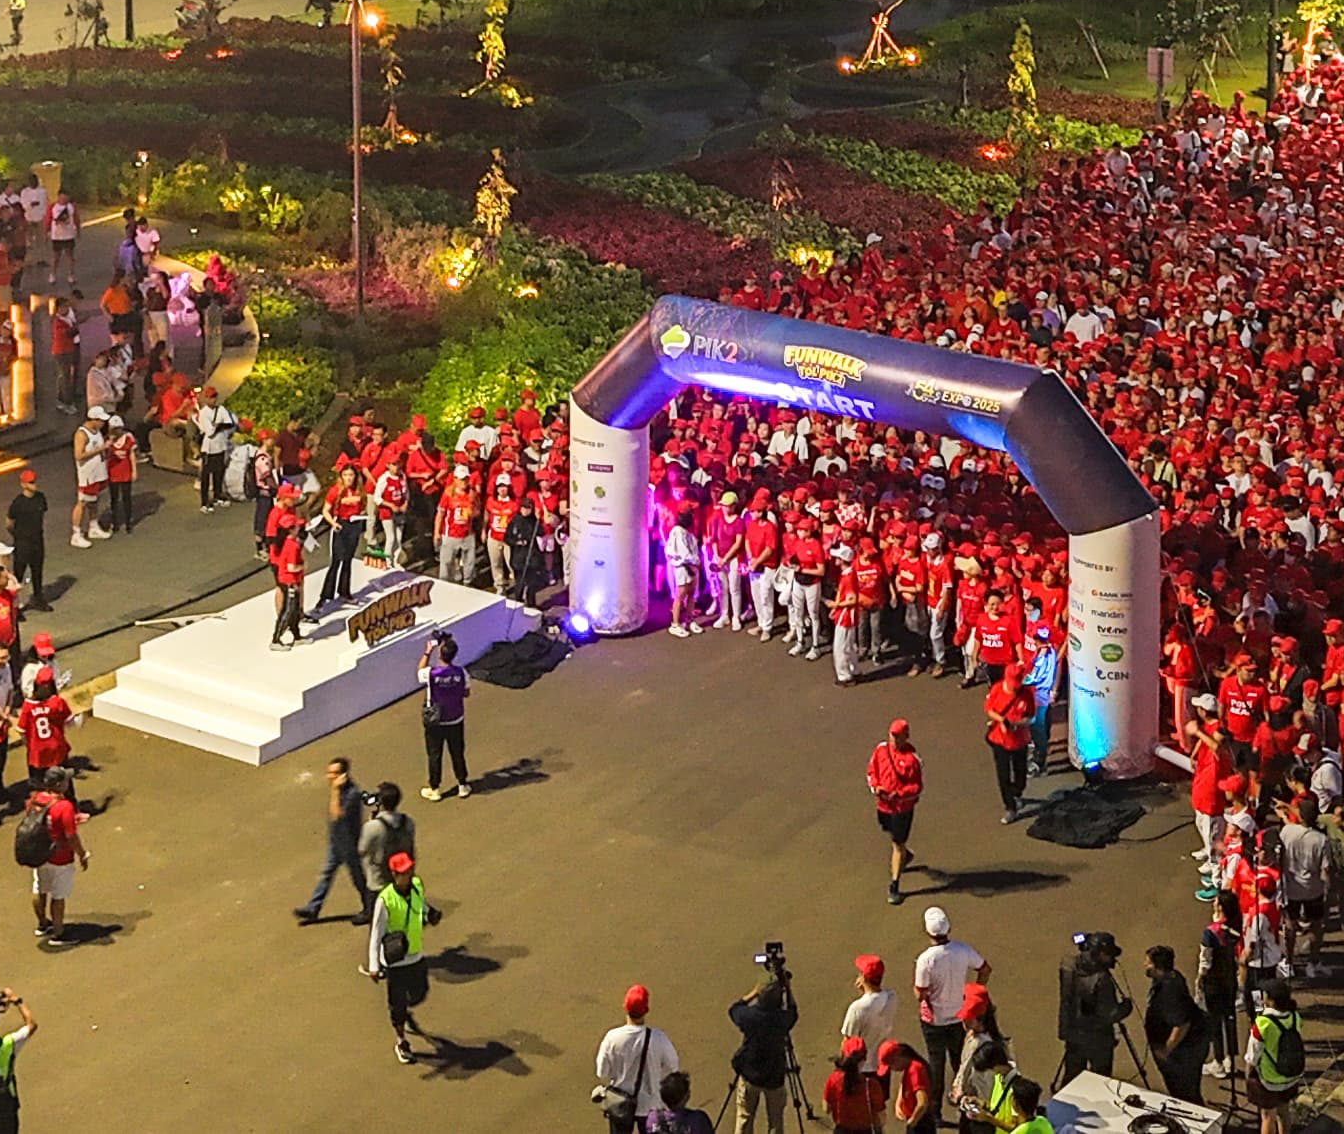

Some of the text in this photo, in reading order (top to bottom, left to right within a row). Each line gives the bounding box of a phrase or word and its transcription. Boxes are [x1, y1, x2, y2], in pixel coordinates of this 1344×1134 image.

[693, 334, 738, 363] PIK2
[784, 346, 867, 380] FUNWALK
[799, 365, 818, 378] TOL
[775, 382, 875, 420] START
[972, 398, 1001, 413] 2025
[348, 581, 434, 643] FUNWALK
[1107, 671, 1128, 680] CBN
[36, 717, 51, 738] 8
